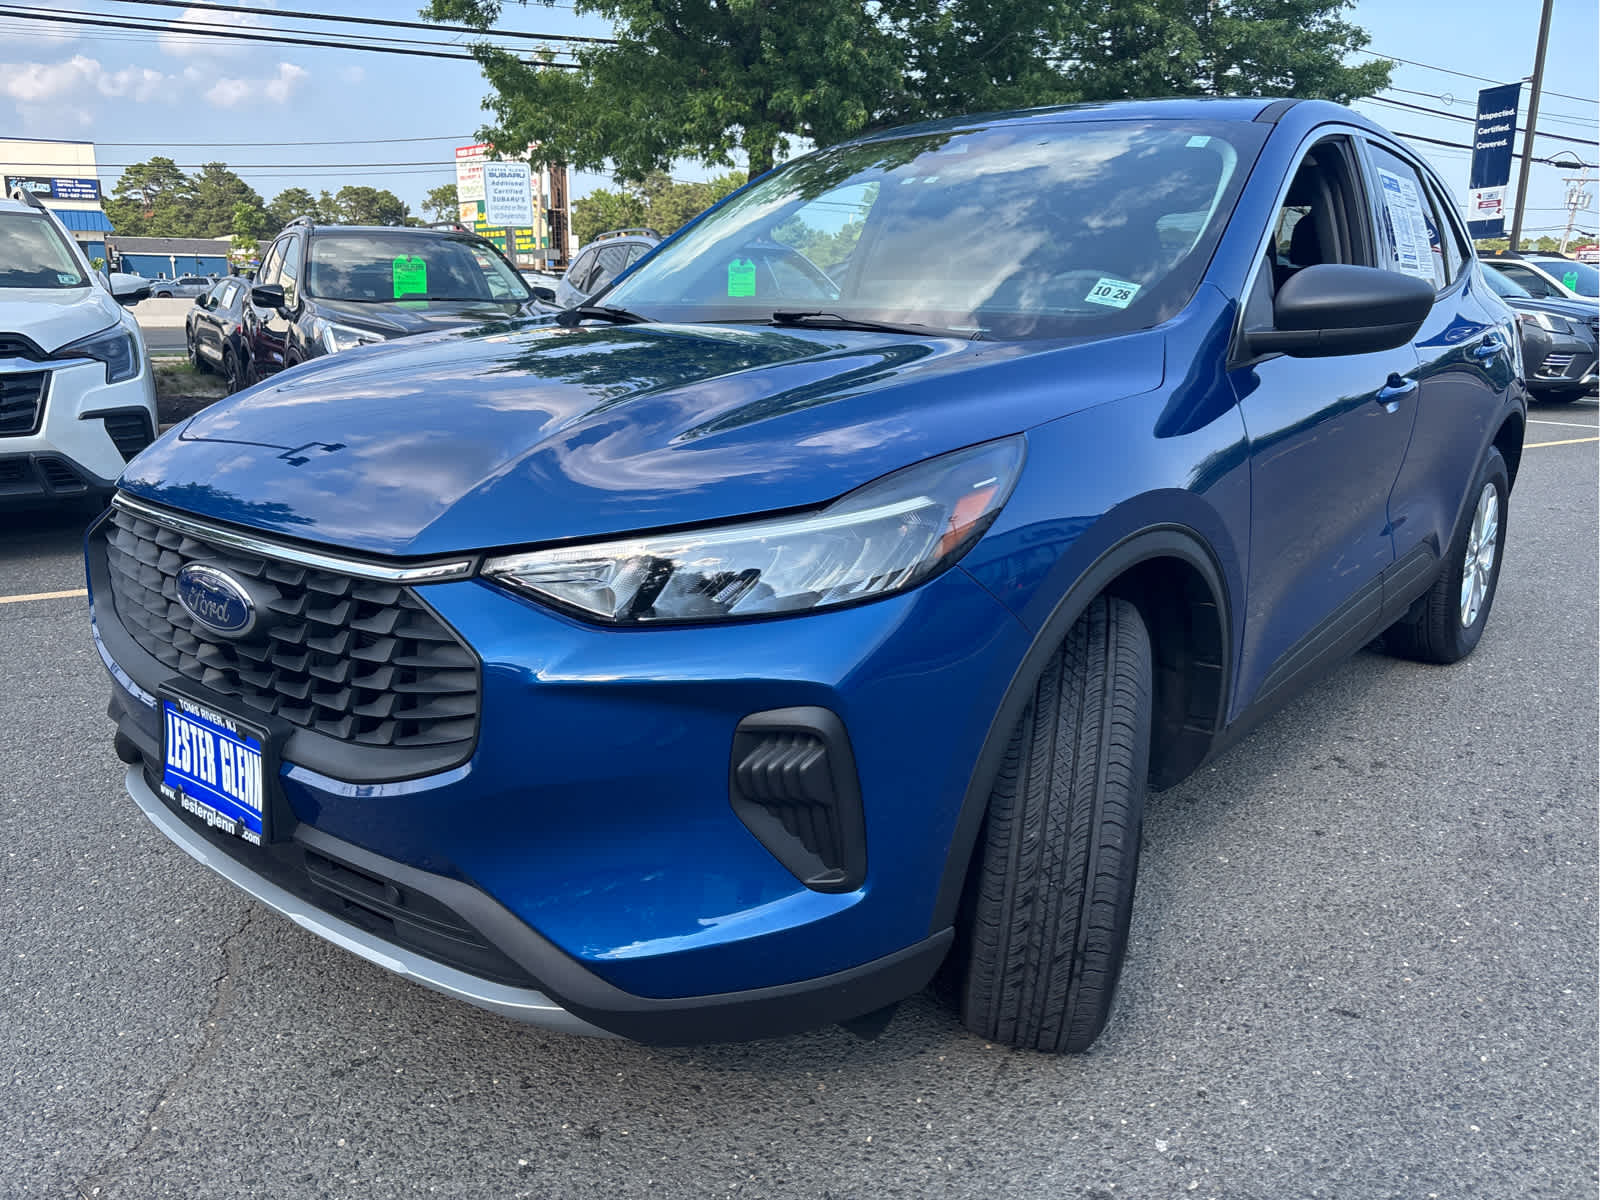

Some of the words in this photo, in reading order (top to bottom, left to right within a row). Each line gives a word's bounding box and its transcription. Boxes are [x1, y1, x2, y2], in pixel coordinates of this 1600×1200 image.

[1479, 108, 1516, 120] Inspected.
[1478, 123, 1510, 135] Certified.
[1476, 138, 1508, 149] Covered.
[1094, 286, 1111, 296] 10
[1113, 289, 1131, 300] 28
[188, 586, 230, 622] Ford
[178, 698, 200, 716] TOMS
[200, 708, 225, 728] RIVER,
[226, 719, 236, 732] NJ
[167, 714, 216, 786] LESTER
[219, 738, 262, 813] GLENN
[181, 793, 235, 835] lesterglenn
[242, 826, 260, 846] .com
